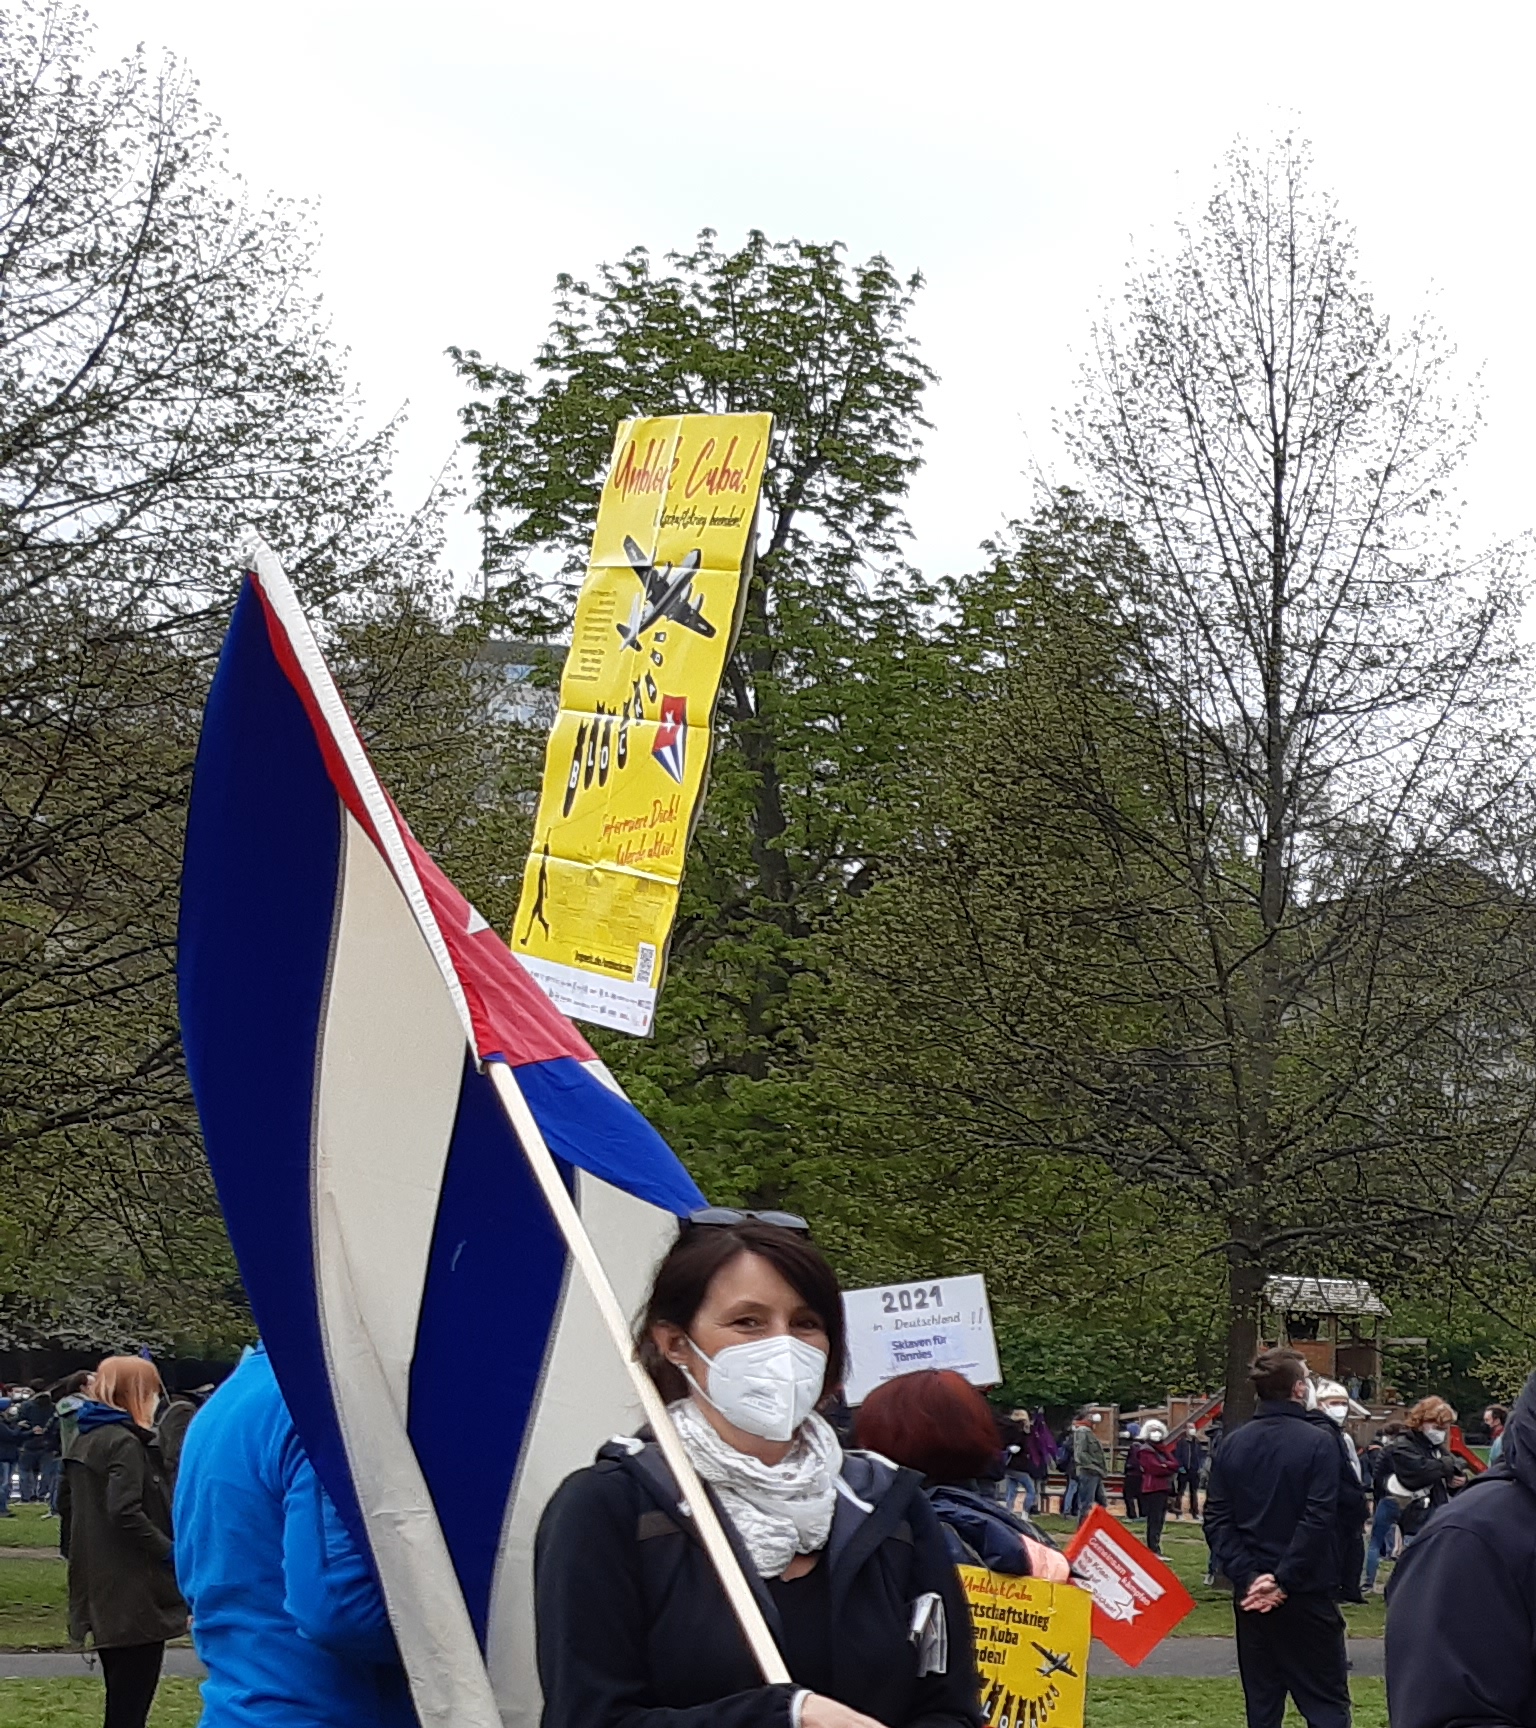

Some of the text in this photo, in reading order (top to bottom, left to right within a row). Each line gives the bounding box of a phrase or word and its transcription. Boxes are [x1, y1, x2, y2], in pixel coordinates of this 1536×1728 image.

[685, 436, 761, 499] Cuba!
[882, 1285, 943, 1313] 2021
[895, 1312, 961, 1330] Deutschland
[892, 1338, 932, 1351] Sklaven
[1089, 1538, 1126, 1576] Gemeinsam
[990, 1626, 1018, 1645] Kuba
